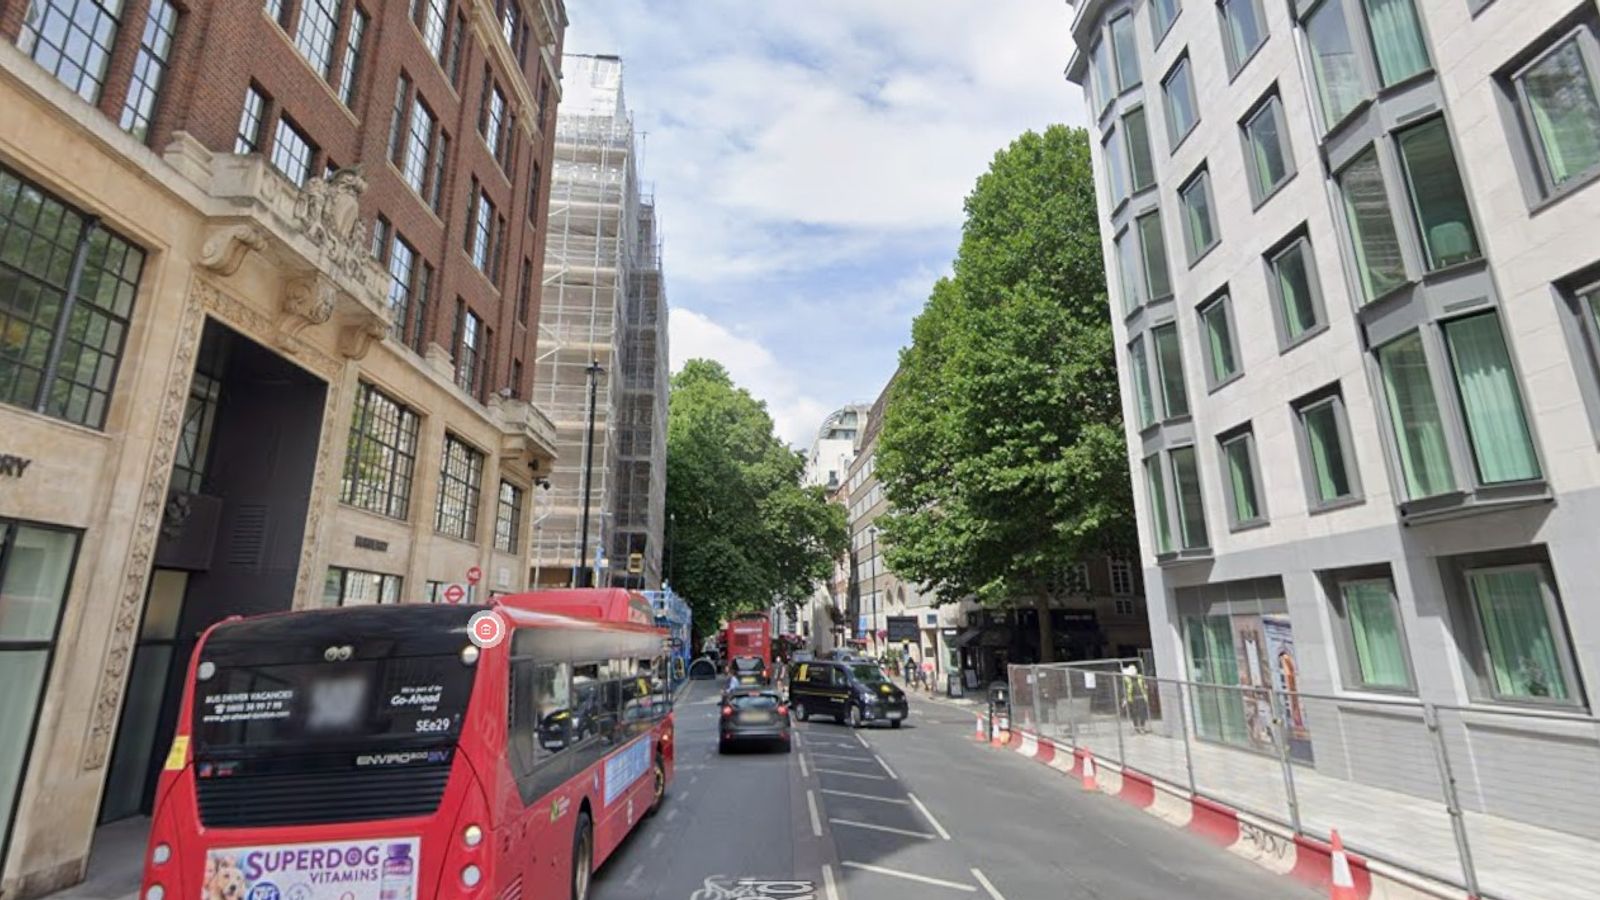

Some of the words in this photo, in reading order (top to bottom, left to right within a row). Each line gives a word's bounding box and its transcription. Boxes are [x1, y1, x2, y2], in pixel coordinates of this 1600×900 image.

[0, 453, 31, 479] RY
[250, 691, 293, 700] VACANCIES
[391, 693, 440, 705] Go-Ahead
[416, 718, 450, 732] SEe29
[245, 847, 380, 881] SUPERDOG
[310, 868, 378, 884] VITAMINS
